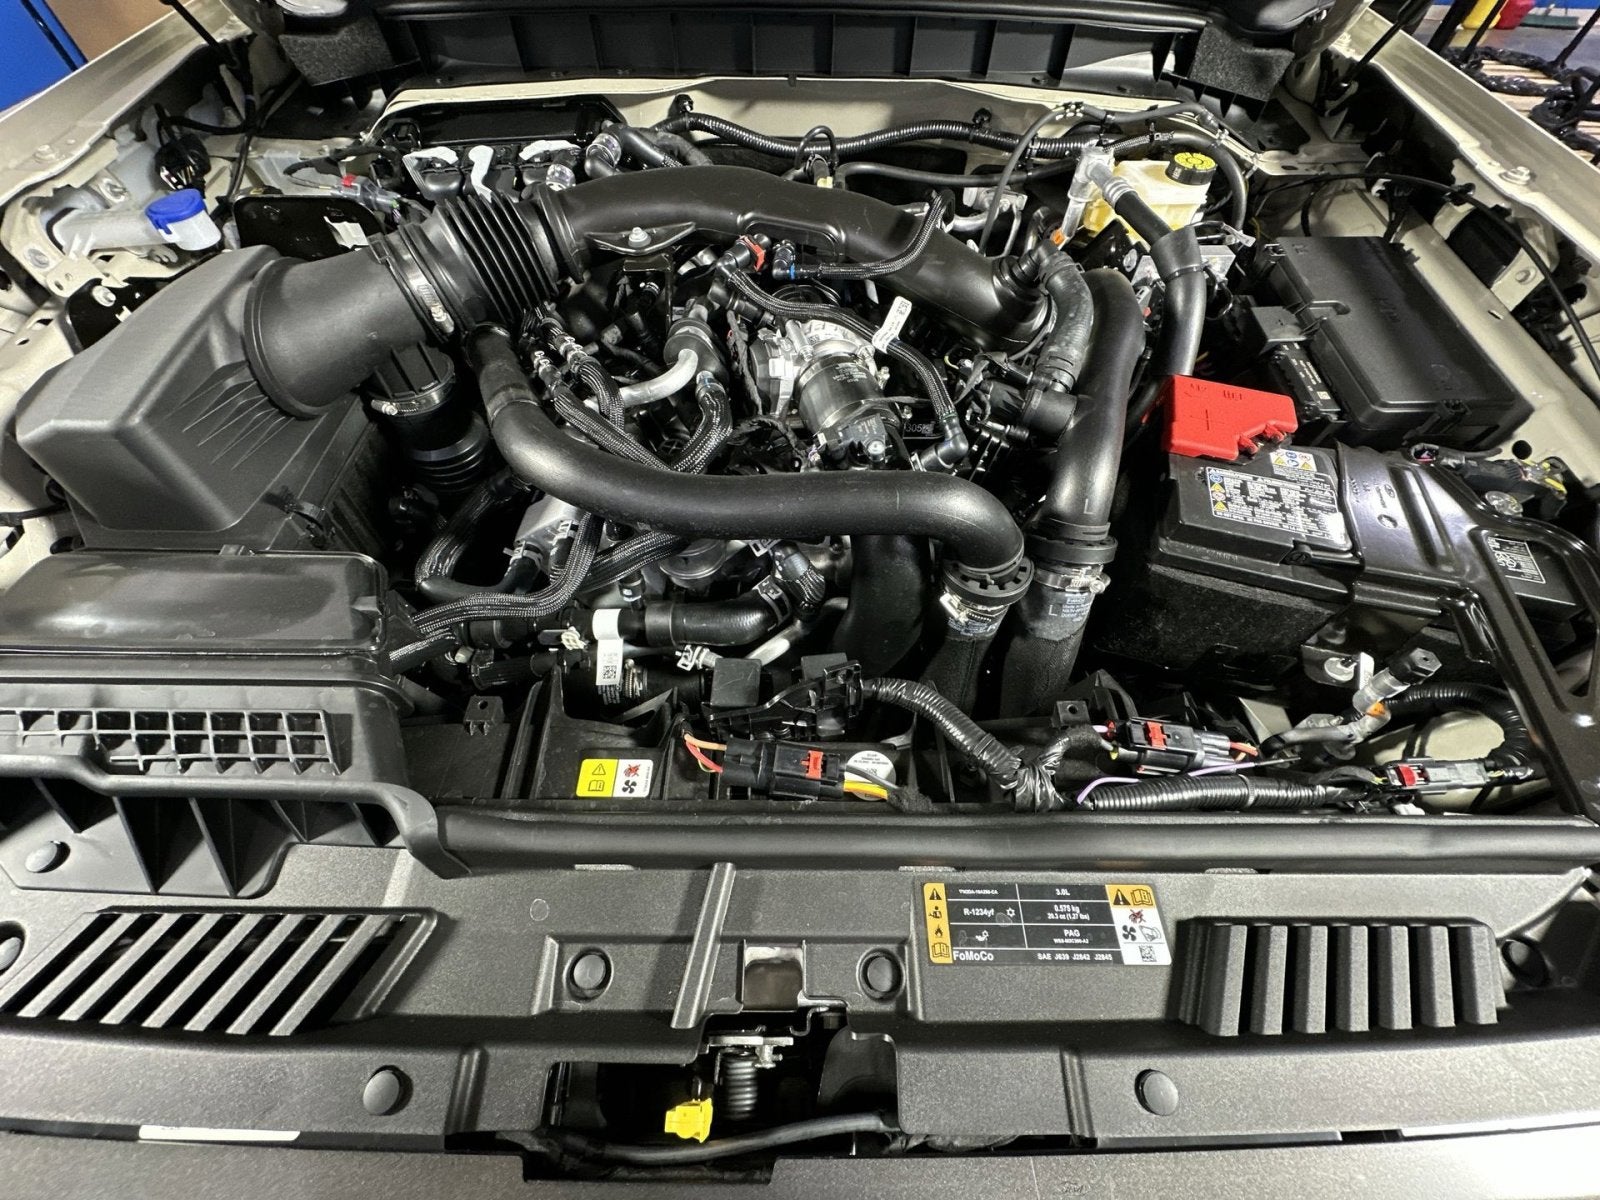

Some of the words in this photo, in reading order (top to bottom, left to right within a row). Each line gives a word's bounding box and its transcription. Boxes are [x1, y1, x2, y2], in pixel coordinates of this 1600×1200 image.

[1056, 888, 1071, 896] 3.0L
[963, 907, 995, 918] R-1234yf
[1071, 904, 1081, 913] kg
[1063, 929, 1081, 938] PAG
[953, 951, 994, 961] FoMoCo
